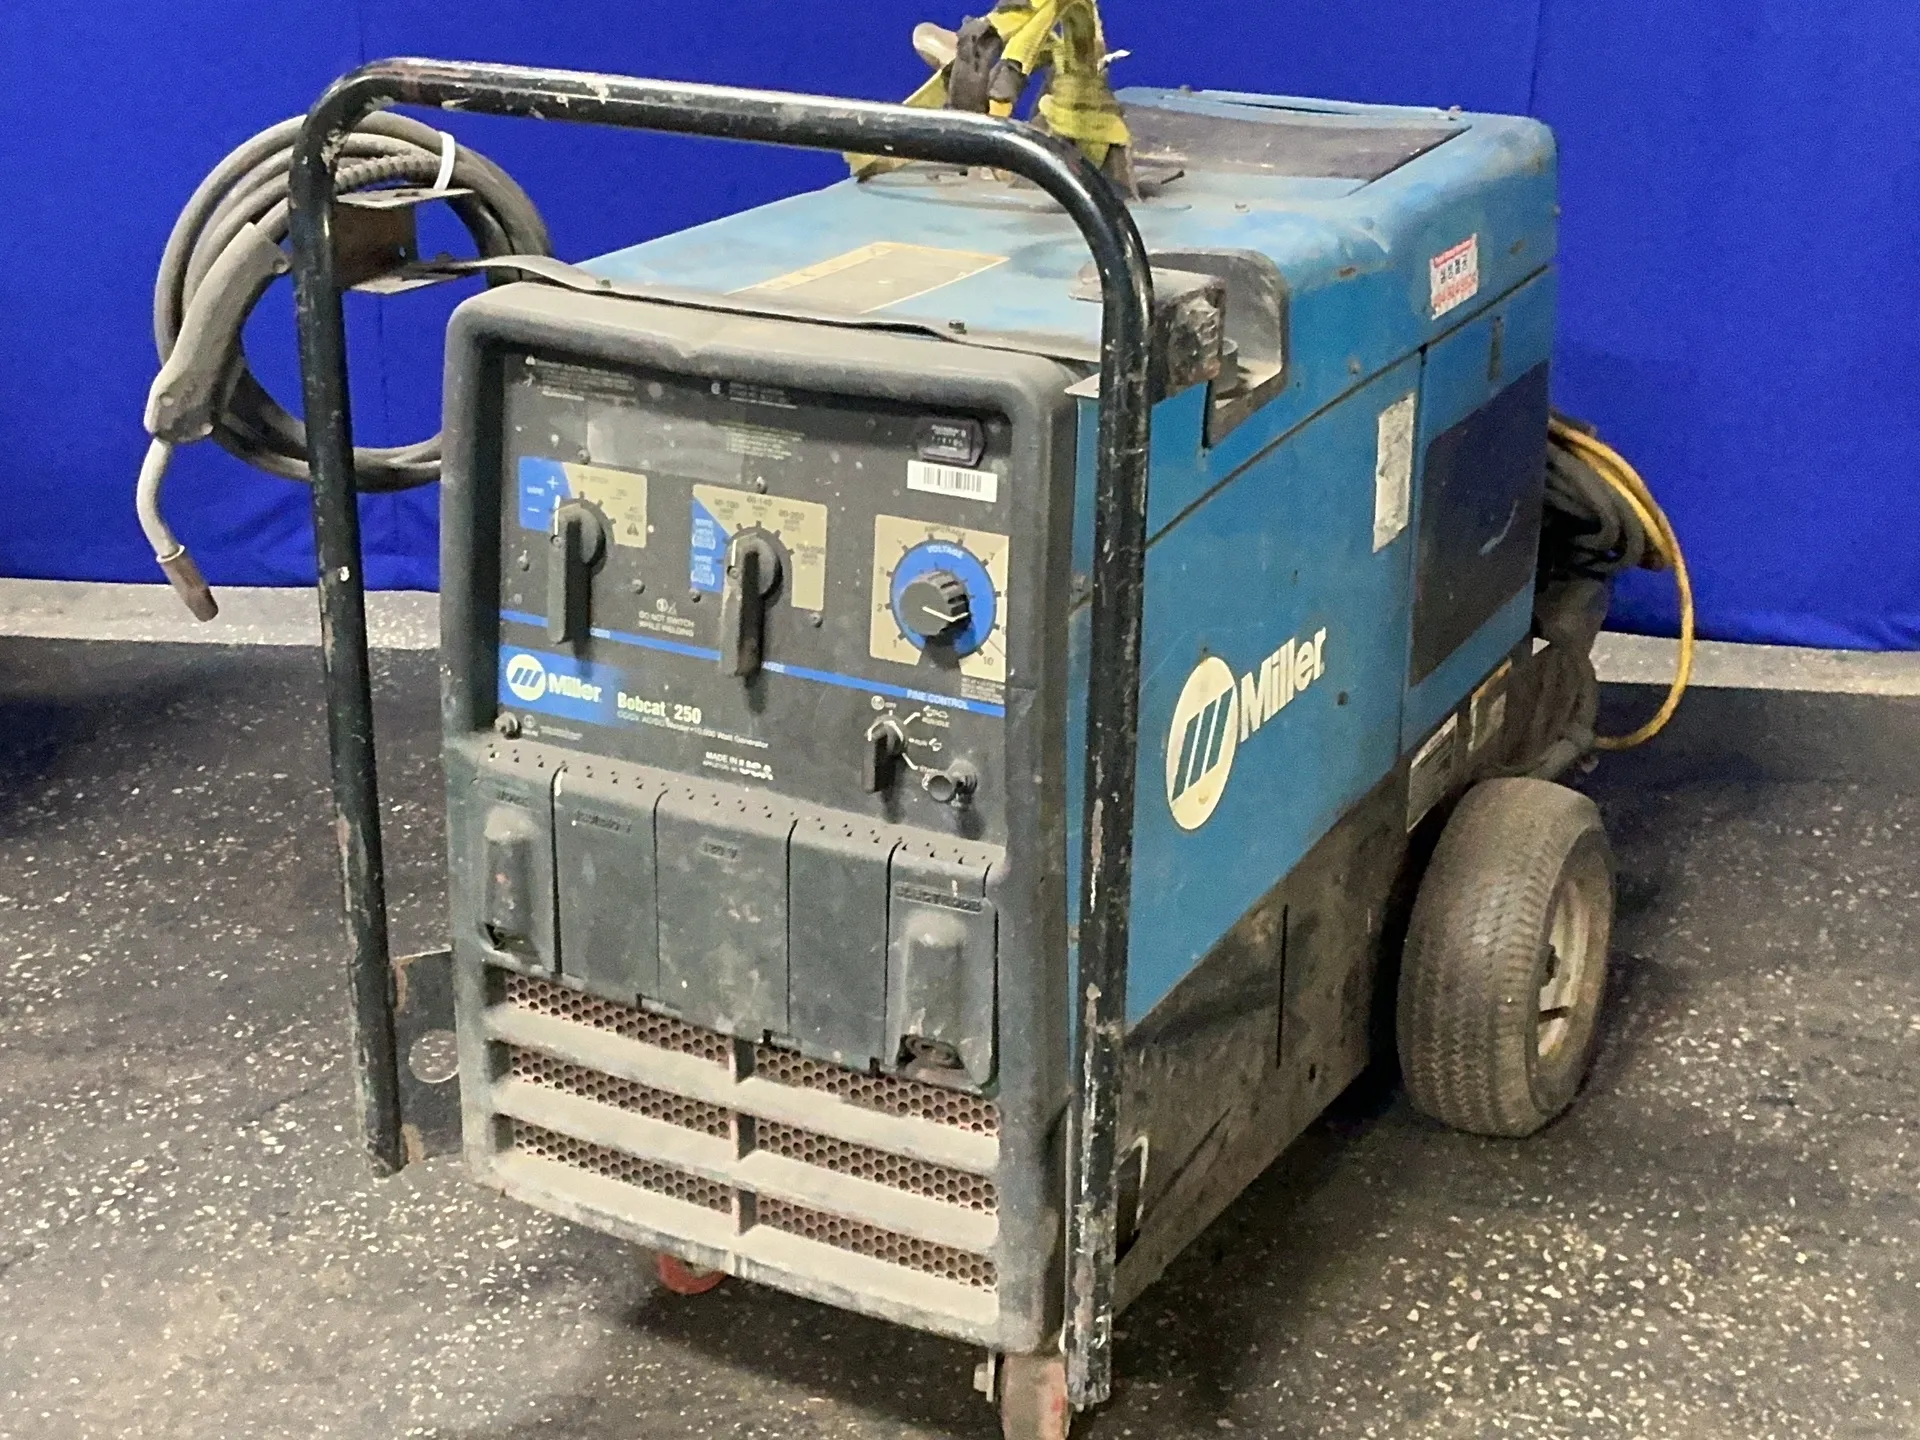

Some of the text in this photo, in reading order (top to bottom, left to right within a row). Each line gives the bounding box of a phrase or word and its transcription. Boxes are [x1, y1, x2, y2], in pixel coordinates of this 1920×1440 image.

[926, 545, 964, 560] VOLTAGE
[877, 604, 883, 612] 2
[983, 656, 994, 666] 10
[548, 672, 602, 703] Miller
[1240, 627, 1326, 743] Miller
[907, 689, 969, 711] FINE CONTROL
[617, 691, 702, 725] Bobcat 250
[734, 735, 769, 749] Generator
[706, 751, 728, 763] MADE
